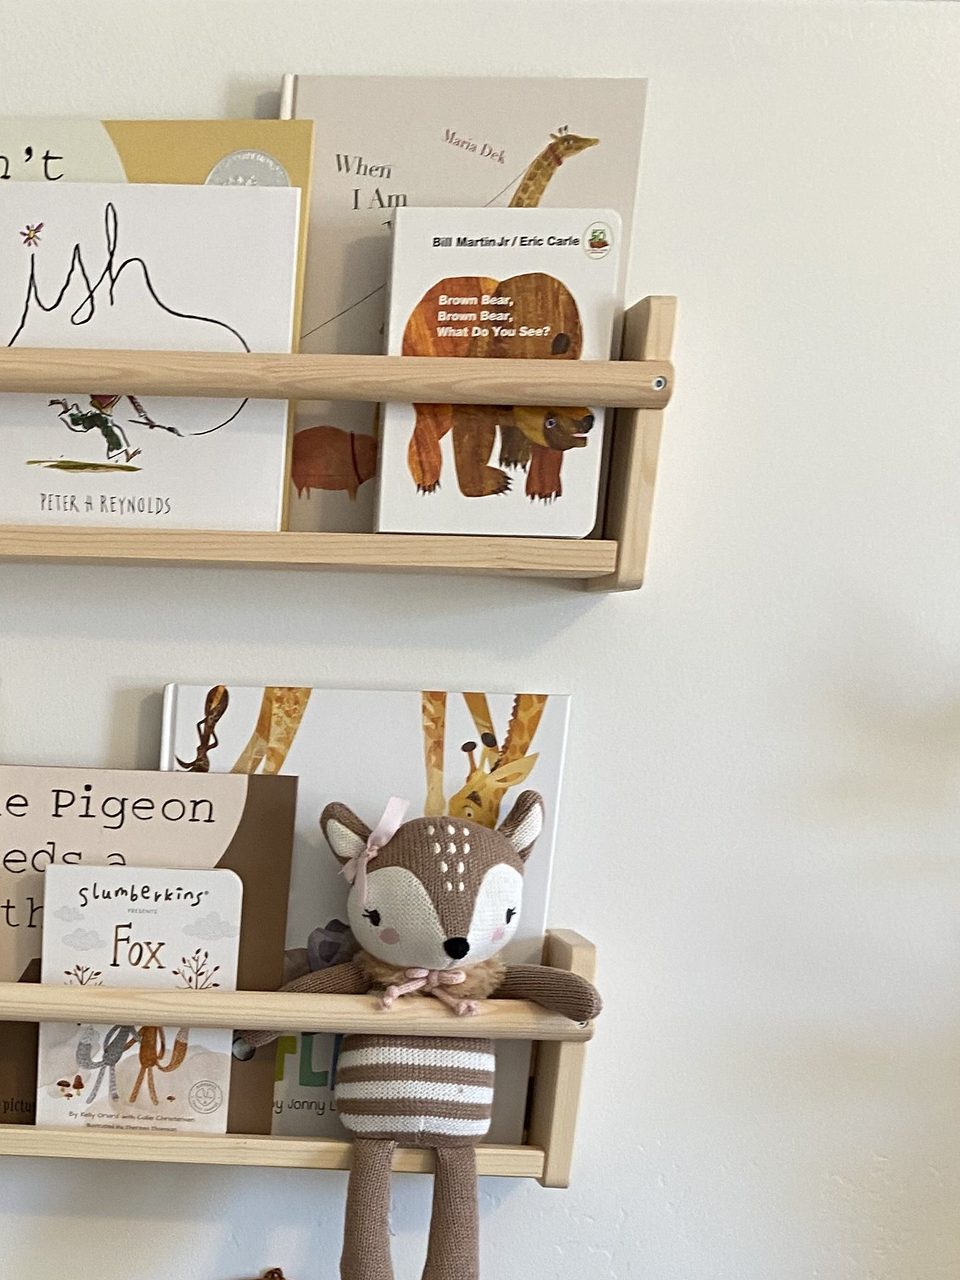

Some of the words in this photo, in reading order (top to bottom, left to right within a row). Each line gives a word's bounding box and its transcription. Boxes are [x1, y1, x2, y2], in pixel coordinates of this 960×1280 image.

[443, 128, 477, 153] Maria
[479, 143, 506, 165] Dek
[335, 153, 393, 179] When
[351, 188, 360, 210] I
[368, 187, 408, 209] Am
[432, 237, 452, 247] Bill
[456, 236, 496, 247] Martin
[497, 236, 511, 247] Jr
[520, 236, 544, 247] Eric
[547, 235, 580, 247] Carle
[439, 295, 478, 306] Brown
[481, 295, 514, 307] Bear,
[437, 311, 477, 322] Brown
[480, 311, 514, 323] Bear,
[437, 326, 469, 337] What
[471, 326, 489, 337] Do
[492, 326, 516, 337] You
[518, 326, 551, 337] See?
[40, 493, 80, 512] PETER
[100, 494, 171, 515] REYNOLDS
[52, 784, 216, 829] Pigeon
